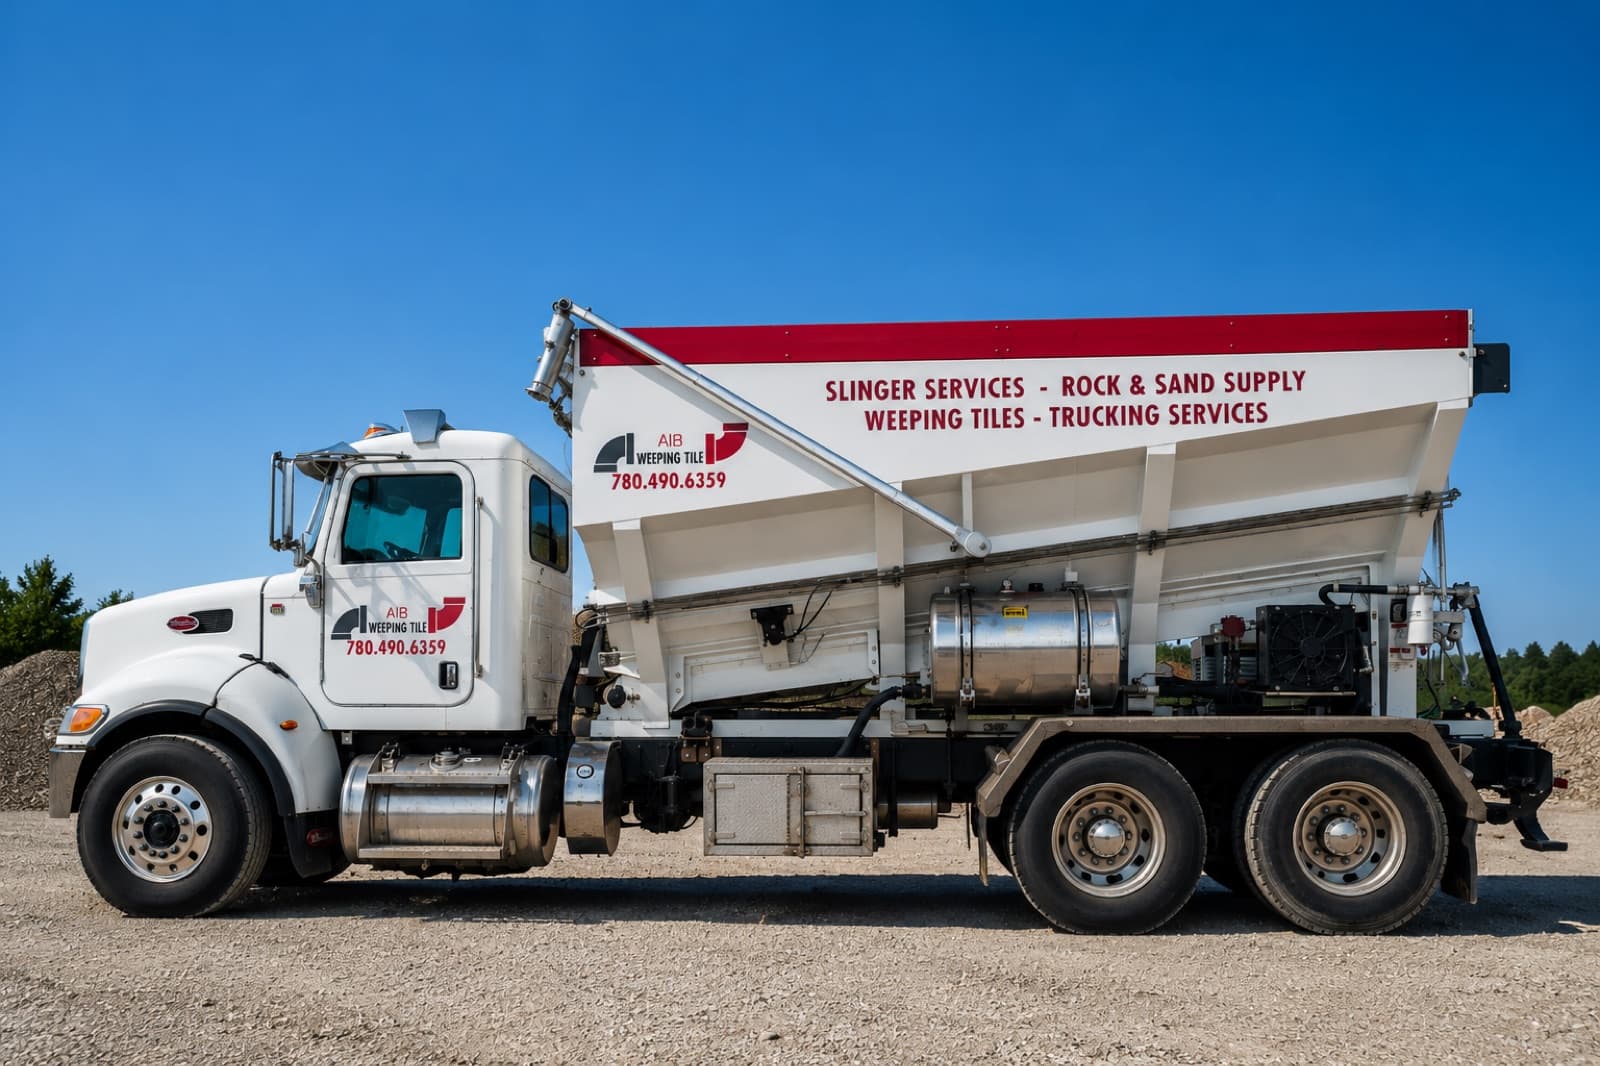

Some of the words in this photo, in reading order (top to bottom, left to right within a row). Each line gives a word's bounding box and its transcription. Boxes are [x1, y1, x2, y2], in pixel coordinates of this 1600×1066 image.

[825, 379, 916, 401] SLINGER
[924, 377, 1025, 399] SERVICES
[1061, 375, 1121, 397] ROCK
[1129, 374, 1146, 396] &
[1155, 372, 1215, 395] SAND
[1223, 370, 1306, 393] SUPPLY
[864, 408, 963, 431] WEEPING
[971, 407, 1025, 429] TILES
[1049, 404, 1160, 428] TRUCKING
[1168, 402, 1269, 426] SERVICES
[658, 433, 683, 447] AIB
[636, 451, 681, 465] WEEPING
[684, 451, 704, 464] TILE
[611, 472, 726, 490] 780.490.6359
[386, 606, 408, 619] AIB
[368, 622, 408, 634] WEEPING
[409, 622, 427, 633] TILE
[346, 639, 446, 655] 780.490.6359
